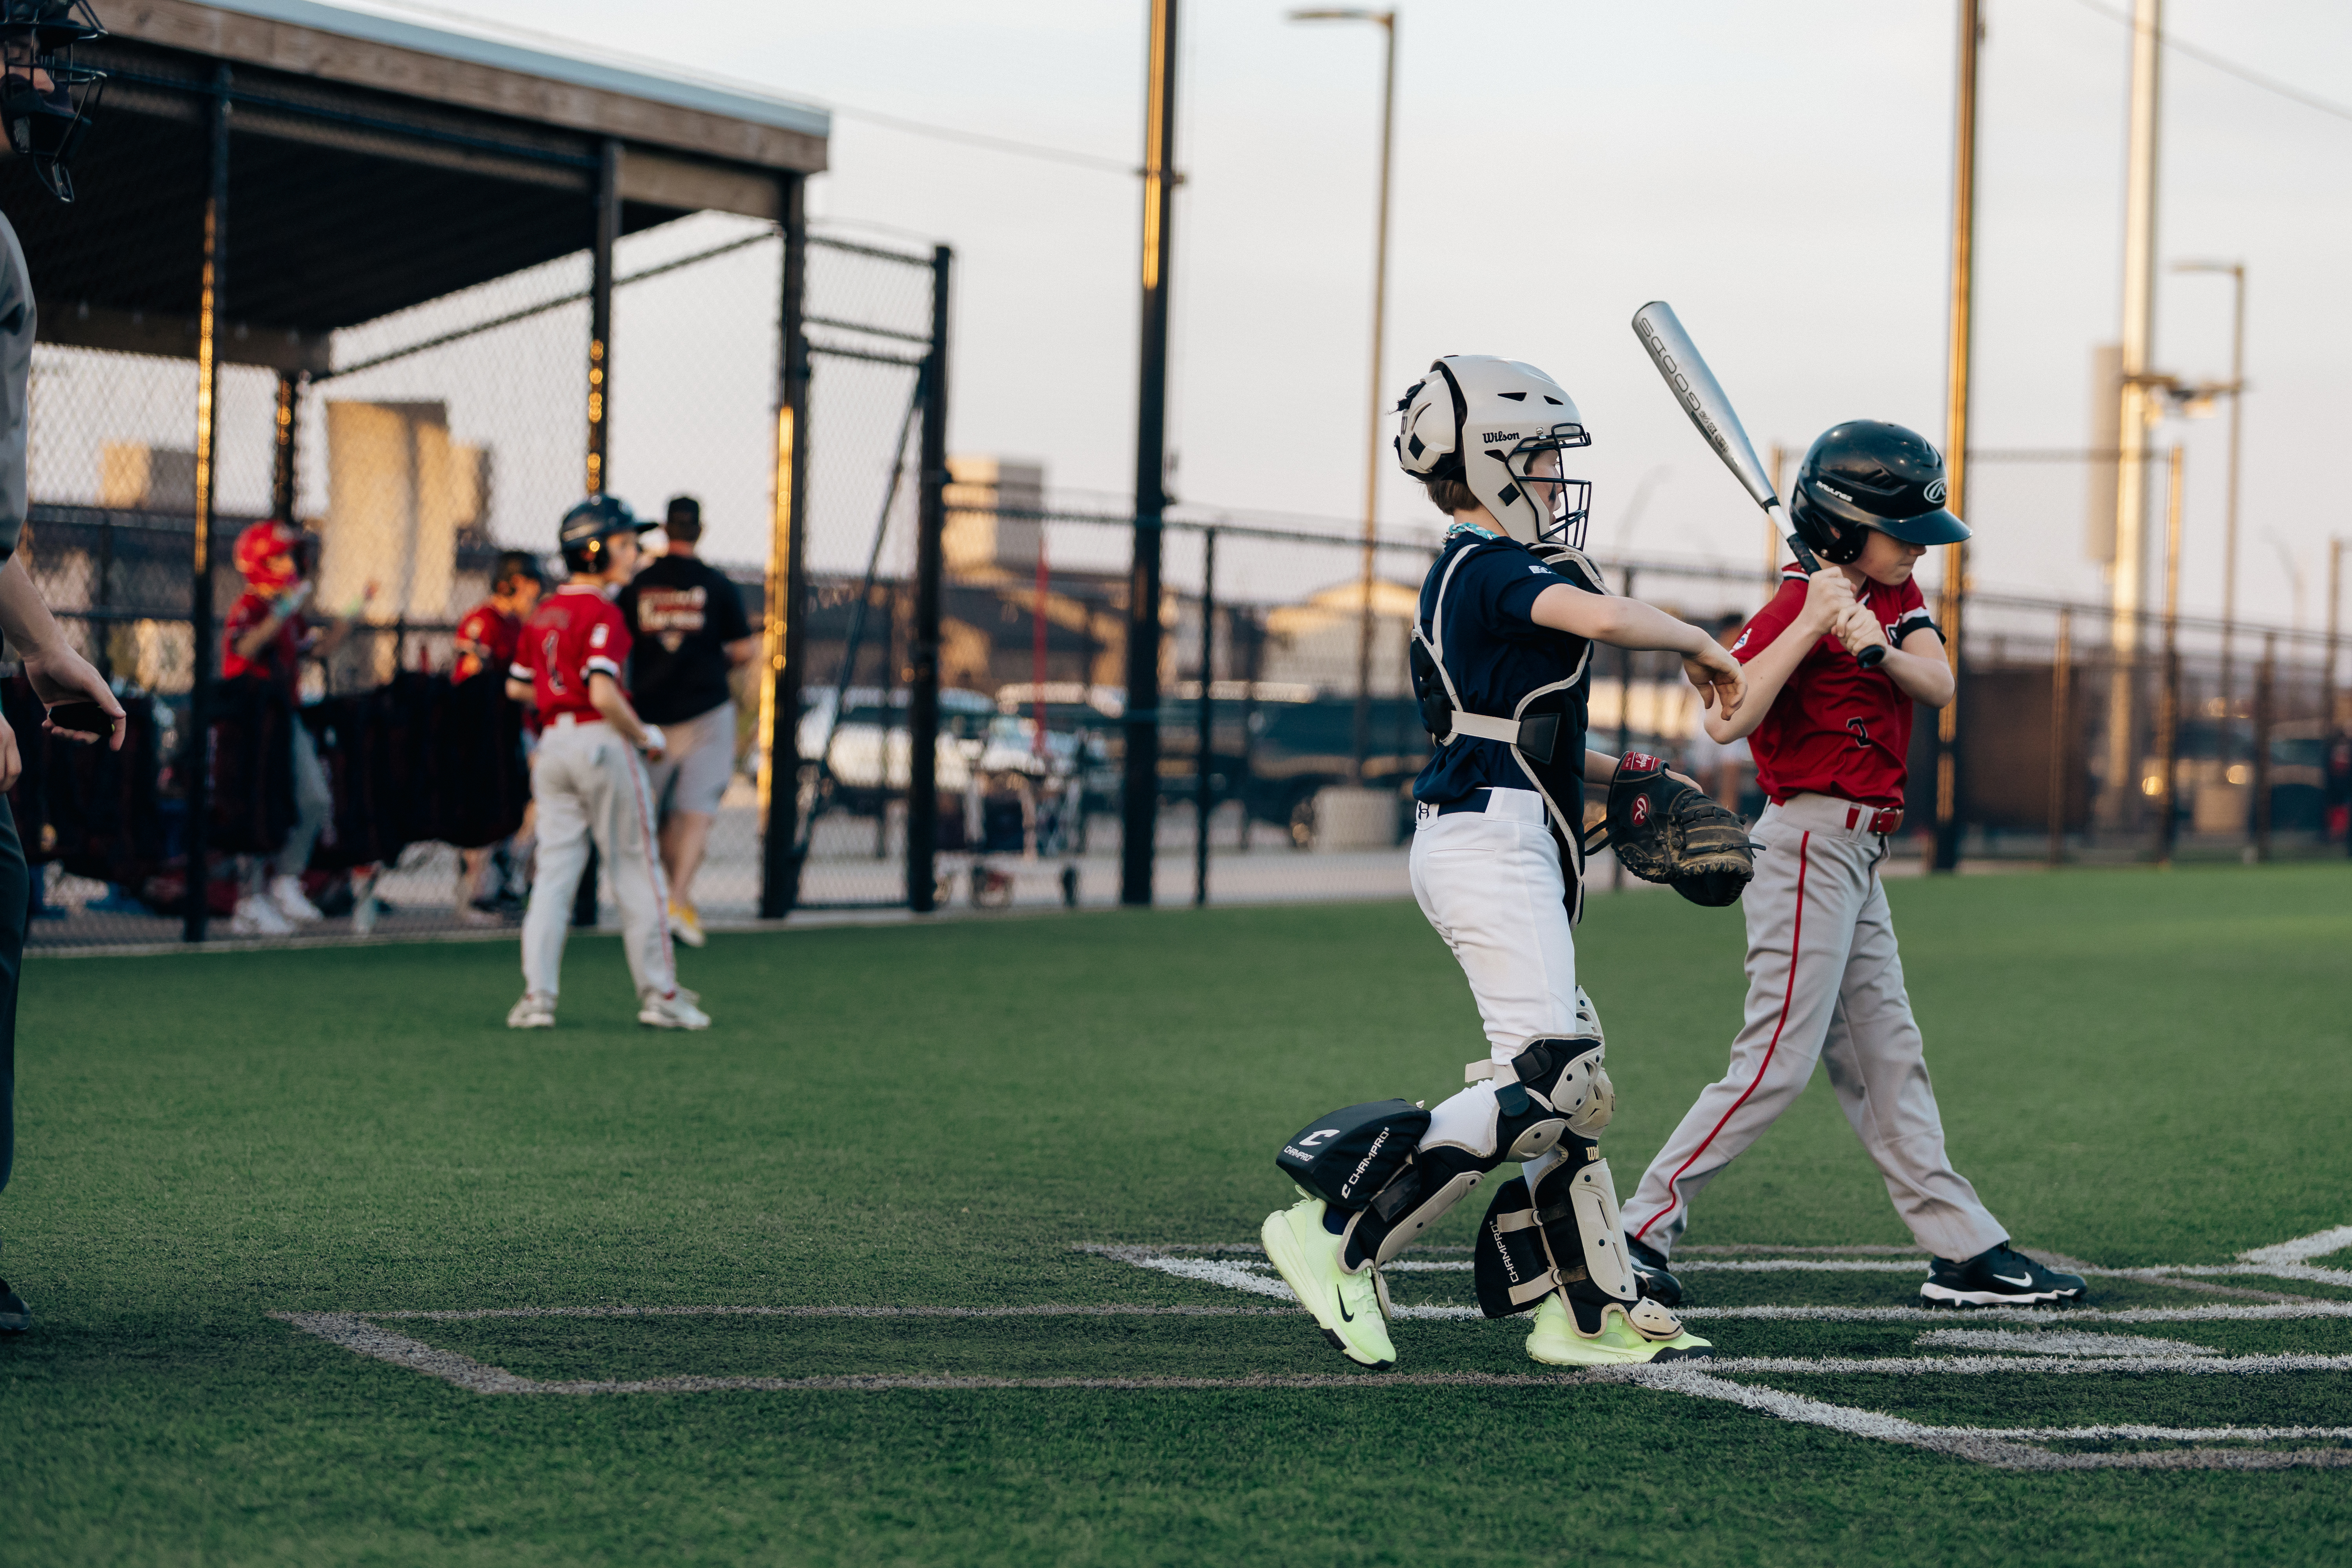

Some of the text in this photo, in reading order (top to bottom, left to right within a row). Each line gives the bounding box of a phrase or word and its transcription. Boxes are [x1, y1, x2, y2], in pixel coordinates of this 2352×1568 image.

[1639, 318, 1700, 410] GOODS
[1482, 431, 1520, 443] Wilson
[1816, 481, 1853, 502] RAWLINGS
[1284, 1145, 1311, 1162] CHAMPRO
[1348, 1131, 1389, 1185] CHAMPRO
[1491, 1224, 1519, 1283] CHAMPRO
